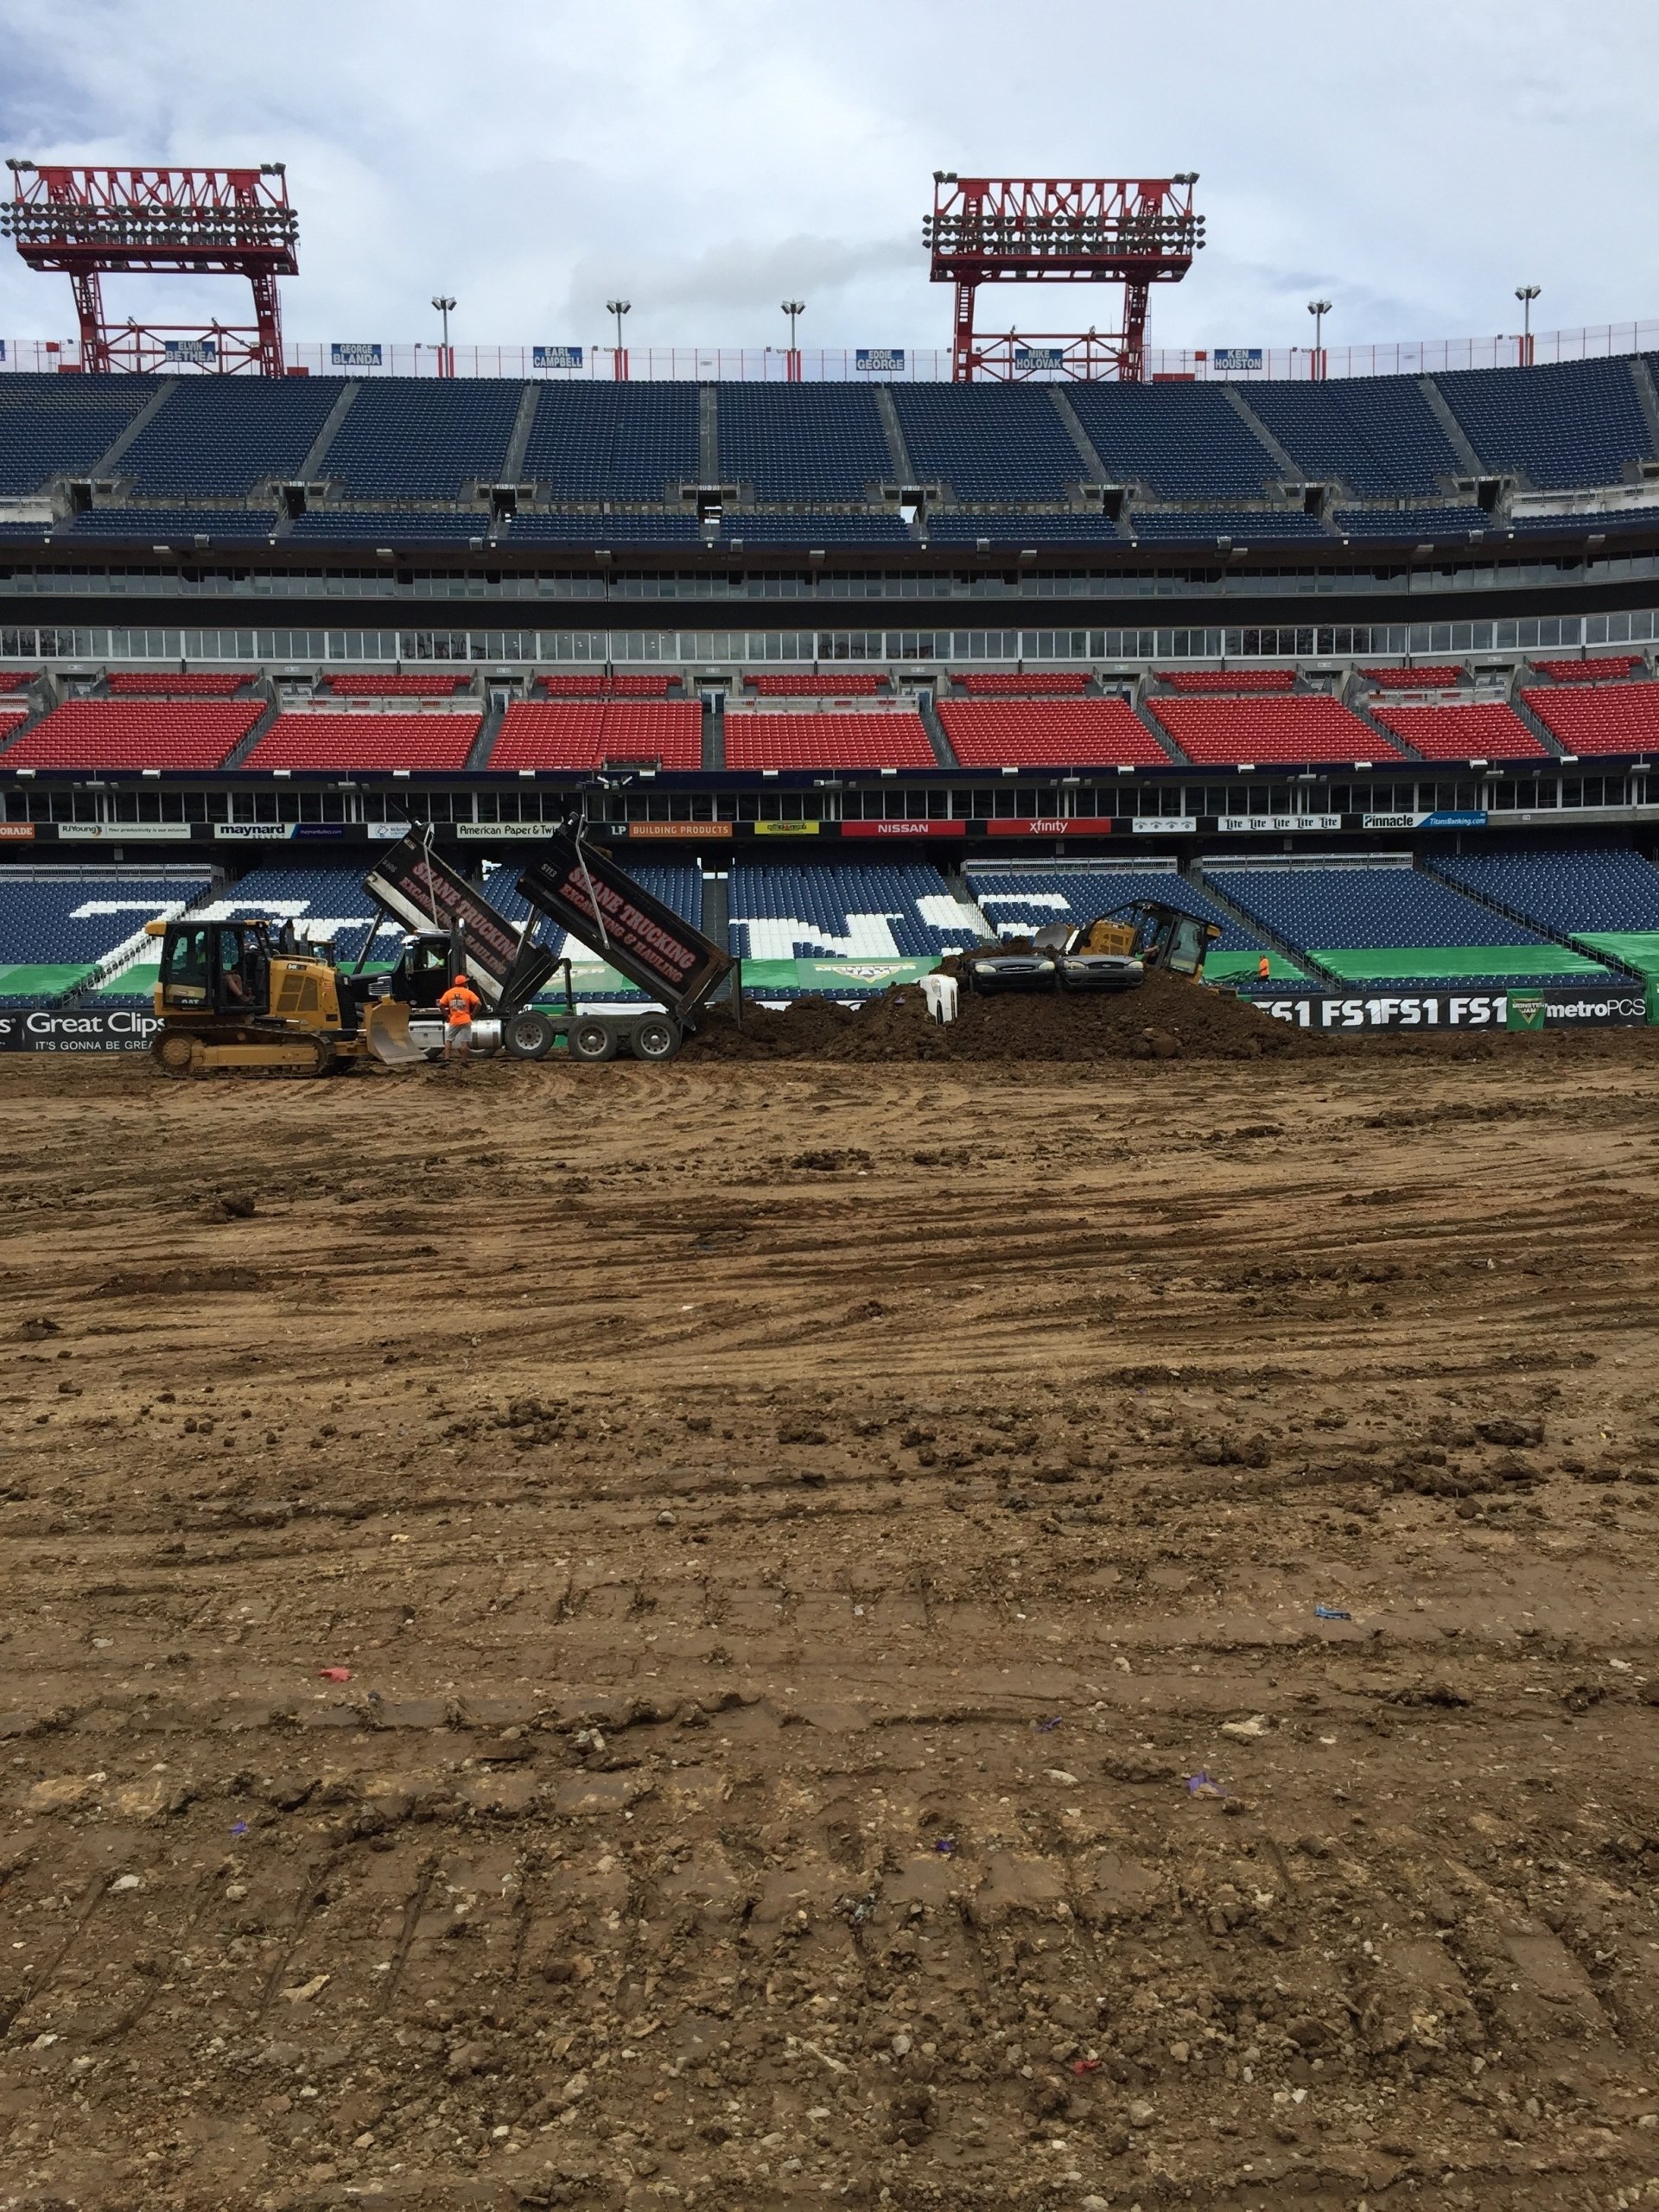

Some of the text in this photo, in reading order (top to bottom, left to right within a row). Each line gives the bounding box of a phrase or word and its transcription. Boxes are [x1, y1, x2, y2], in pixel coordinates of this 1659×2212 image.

[178, 341, 203, 351] ELVIN
[340, 344, 372, 353] GEORGE
[165, 351, 216, 361] BETHEA
[544, 347, 570, 357] EARL
[868, 350, 892, 359] EDDIE
[1027, 349, 1050, 359] MIKE
[1227, 349, 1249, 359] KEN
[332, 353, 381, 365] BLANDA
[534, 356, 582, 367] CAMPBELL
[856, 359, 904, 370] GEORGE
[1016, 358, 1062, 369] HOLOVAK
[1215, 359, 1262, 369] HOUSTON
[1225, 816, 1338, 830] Lite Lite Lite Lite Lite
[1364, 814, 1414, 827] Pinnacle
[0, 827, 33, 836] ORADE
[220, 823, 285, 837] maynard
[460, 824, 502, 836] American
[505, 824, 531, 836] Paper
[532, 825, 540, 835] &
[611, 825, 626, 836] LP
[632, 825, 729, 835] BUILDING PRODUCTS
[879, 823, 930, 833] NISSAN
[1030, 820, 1069, 834] xfinity
[412, 861, 518, 961] SHANE TRUCKING
[568, 867, 625, 914] SHANE
[620, 904, 696, 969] TRUCKING
[624, 934, 633, 945] &
[632, 939, 684, 983] HAULING
[1322, 999, 1381, 1027] FS1
[1381, 998, 1439, 1025] FS1
[1449, 997, 1507, 1024] FS1
[1546, 998, 1646, 1018] metroPCS
[27, 1011, 105, 1033] Great
[36, 1039, 155, 1051] IT'S GONNA BE GREA
